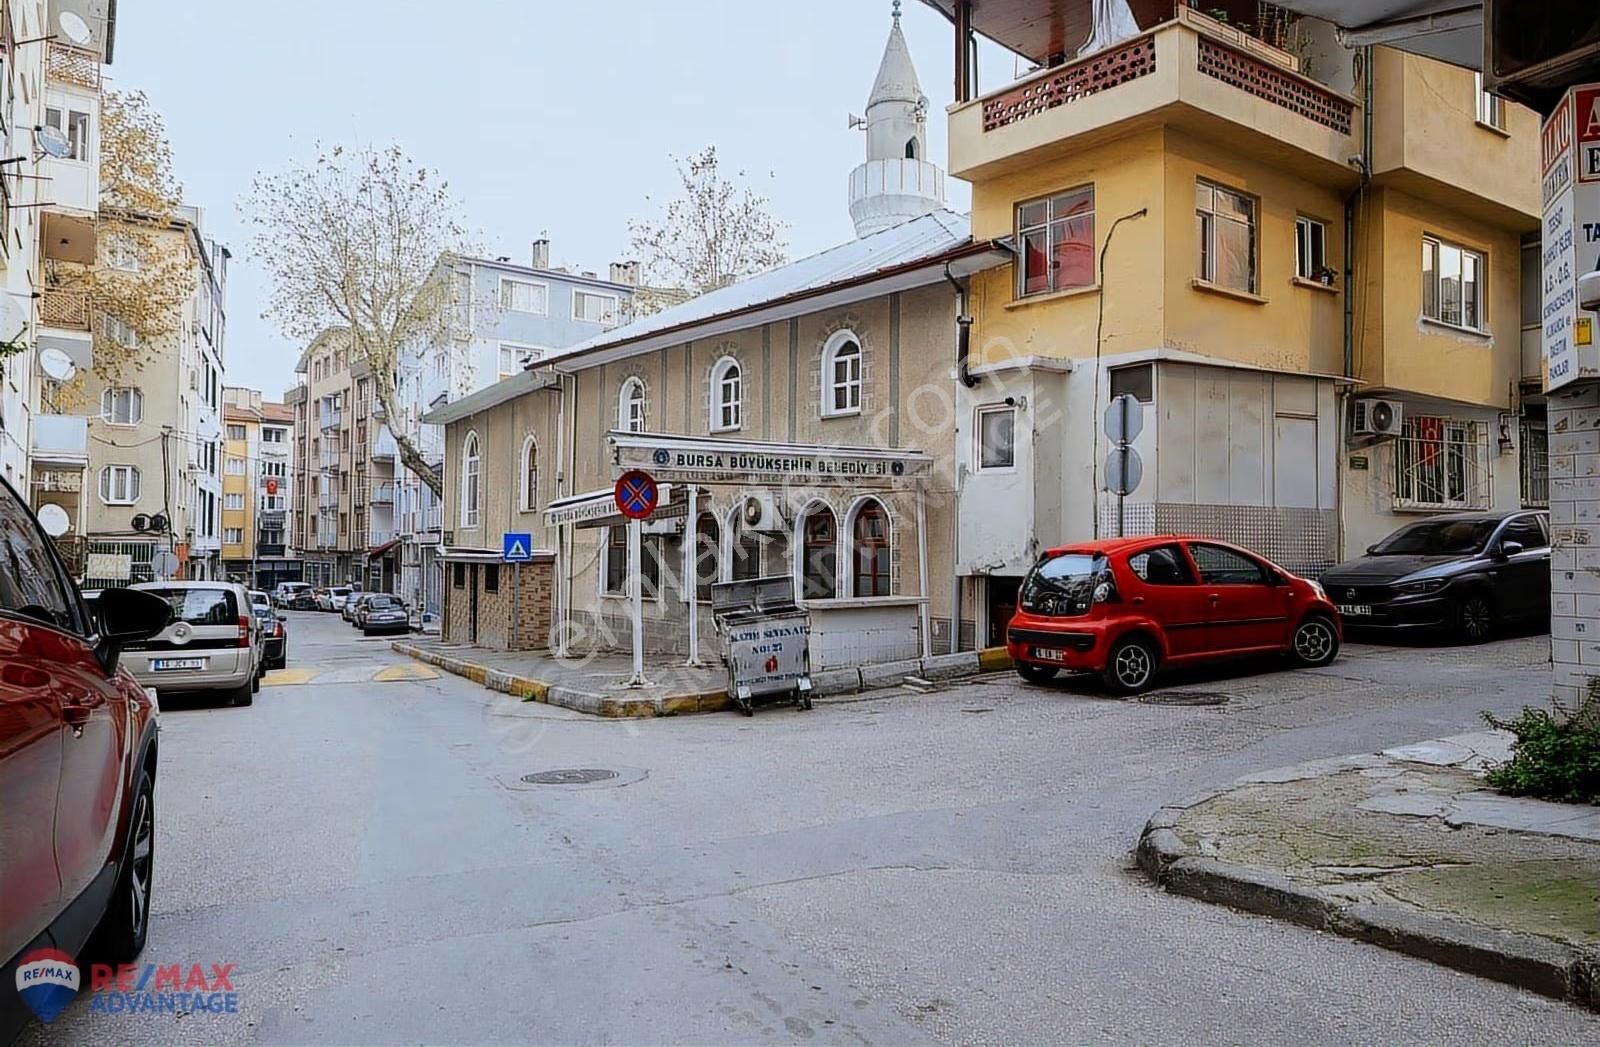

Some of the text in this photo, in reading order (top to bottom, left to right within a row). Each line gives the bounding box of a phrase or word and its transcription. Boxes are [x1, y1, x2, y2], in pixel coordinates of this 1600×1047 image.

[676, 453, 887, 475] BURSA BÜYÜKŞEHİR BELEDİYESİ
